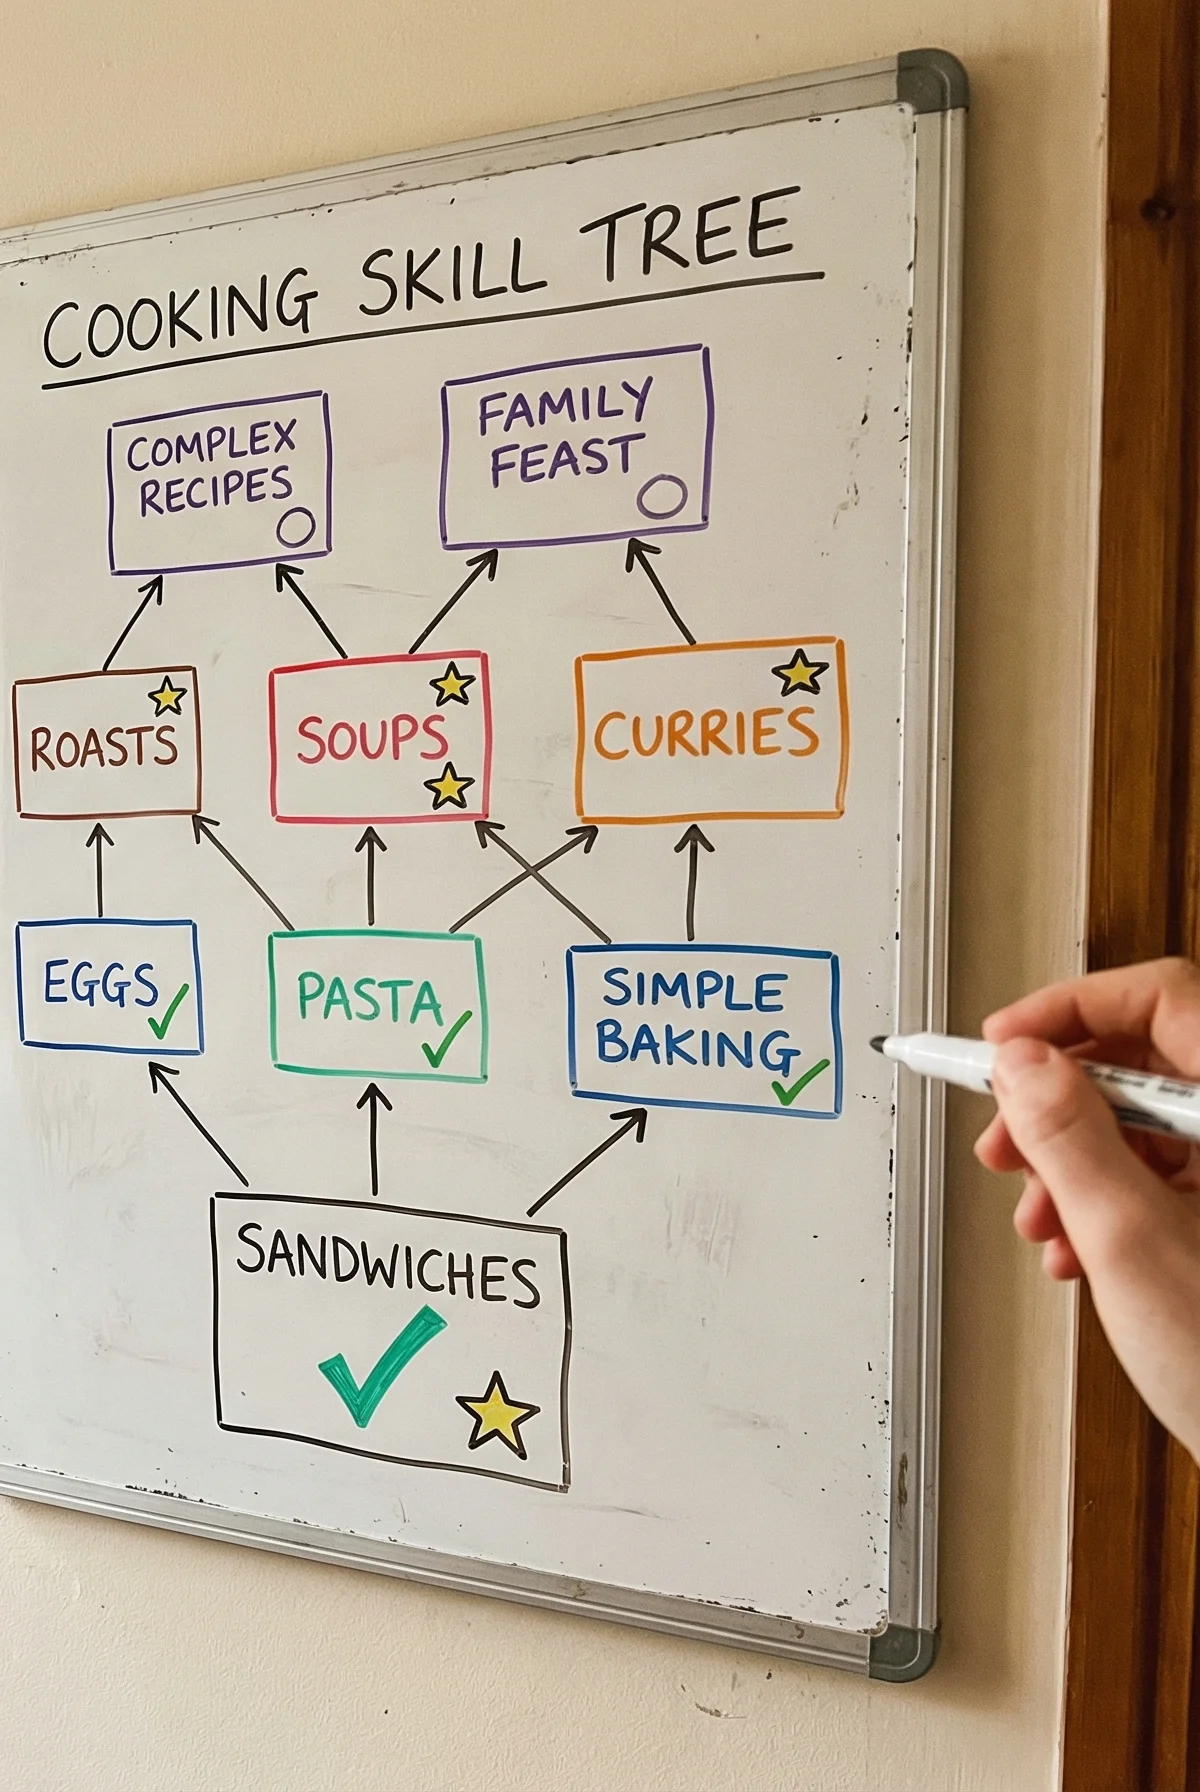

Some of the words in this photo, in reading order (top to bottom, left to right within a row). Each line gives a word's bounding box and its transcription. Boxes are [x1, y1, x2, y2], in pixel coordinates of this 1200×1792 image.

[43, 266, 319, 369] COOKING
[358, 236, 549, 316] SKILL
[578, 185, 802, 283] TREE
[479, 375, 654, 437] FAMILY
[127, 418, 298, 474] COMPLEX
[491, 432, 647, 489] FEAST
[140, 464, 293, 518] RECIPES
[31, 724, 179, 773] ROASTS
[297, 713, 449, 765] SOUPS
[593, 705, 820, 761] CURRIES
[44, 958, 159, 1009] EGGS
[297, 971, 444, 1027] PASTA
[602, 966, 789, 1013] SIMPLE
[595, 1018, 802, 1079] BAKING
[236, 1222, 541, 1310] SANDWICHES
